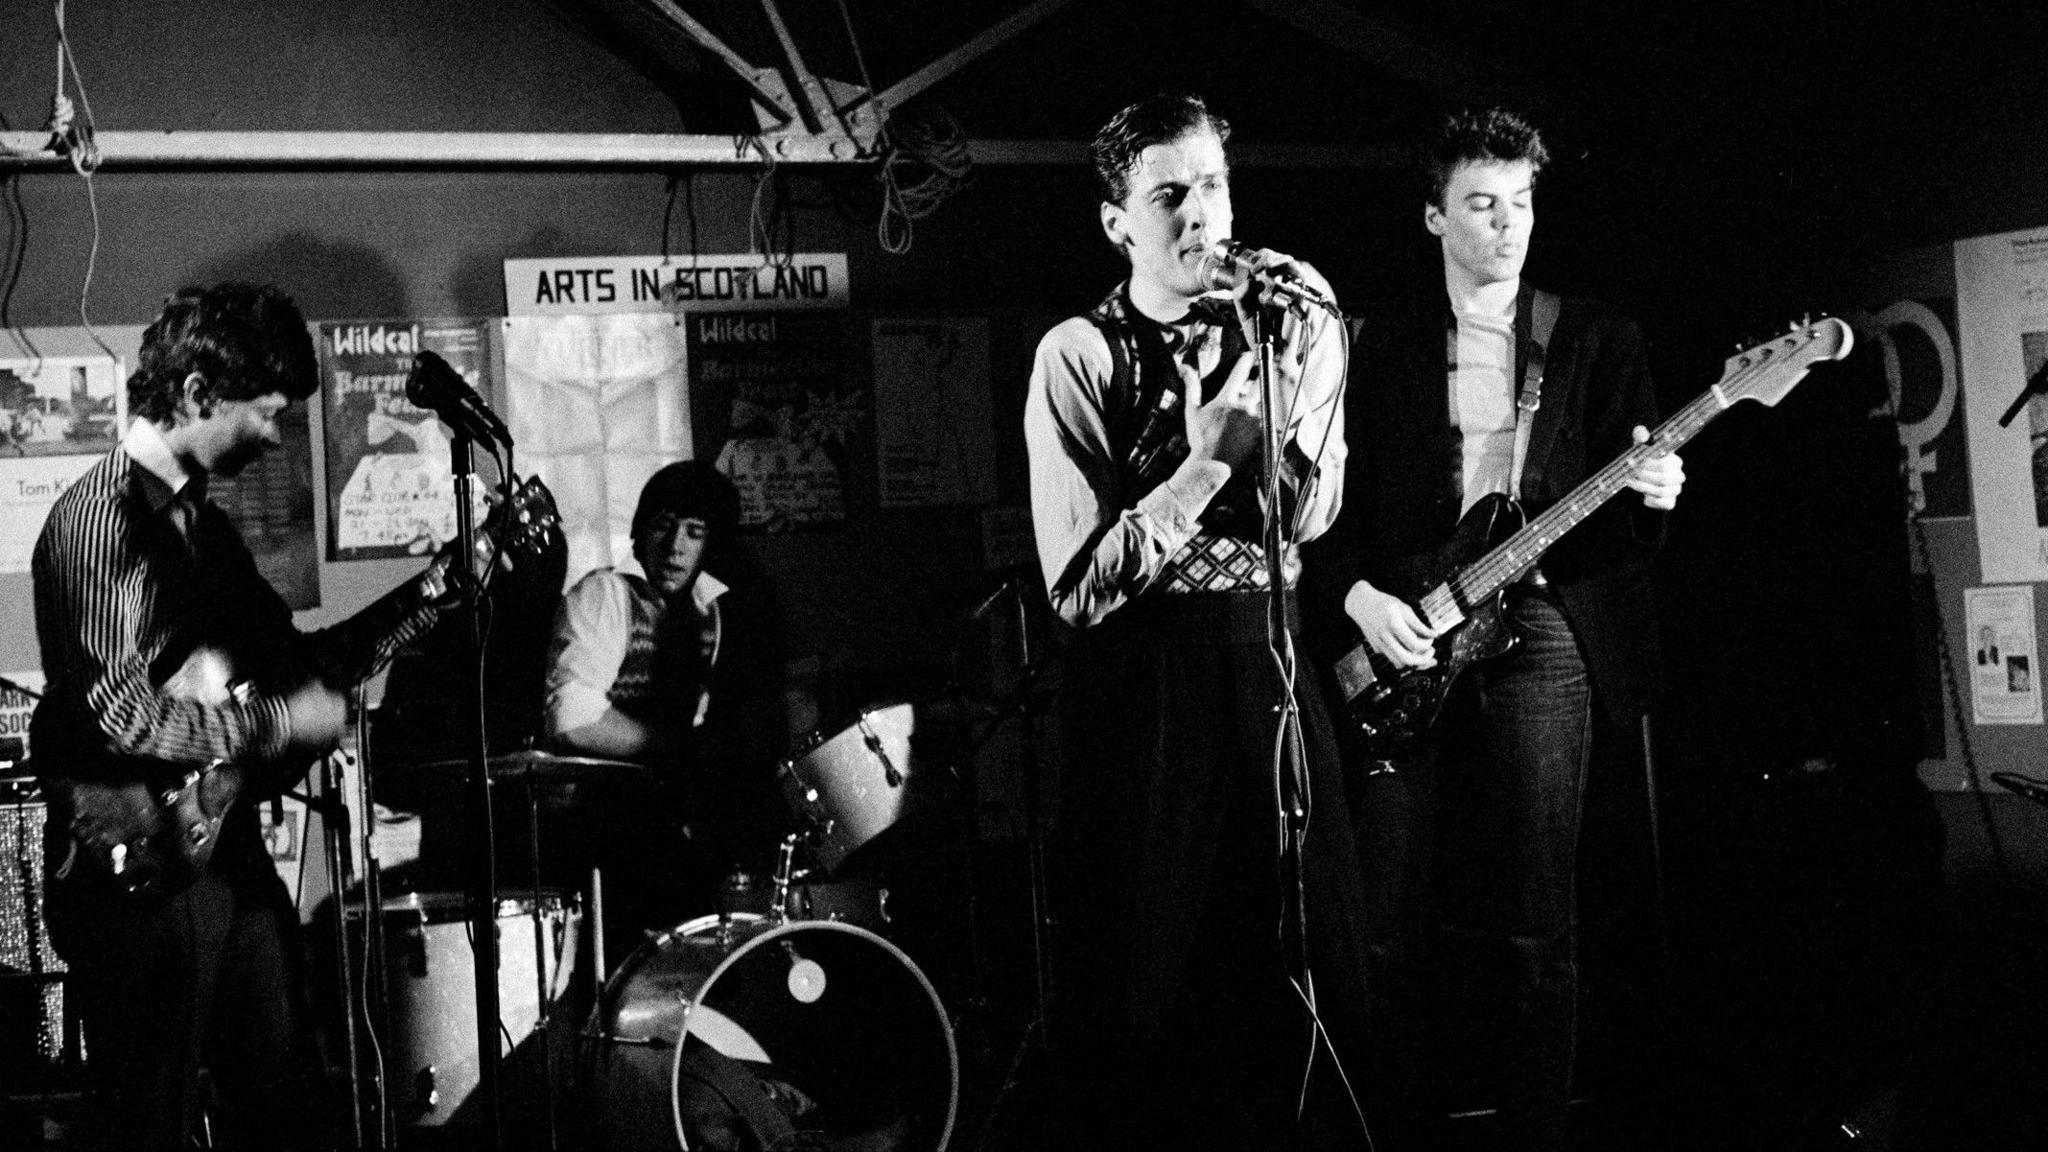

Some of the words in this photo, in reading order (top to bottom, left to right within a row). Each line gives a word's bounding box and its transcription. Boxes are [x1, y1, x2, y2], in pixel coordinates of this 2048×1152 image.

[536, 268, 616, 304] ARTS
[631, 267, 661, 302] IN
[675, 265, 829, 301] SCOTLAND
[17, 480, 50, 496] Tom
